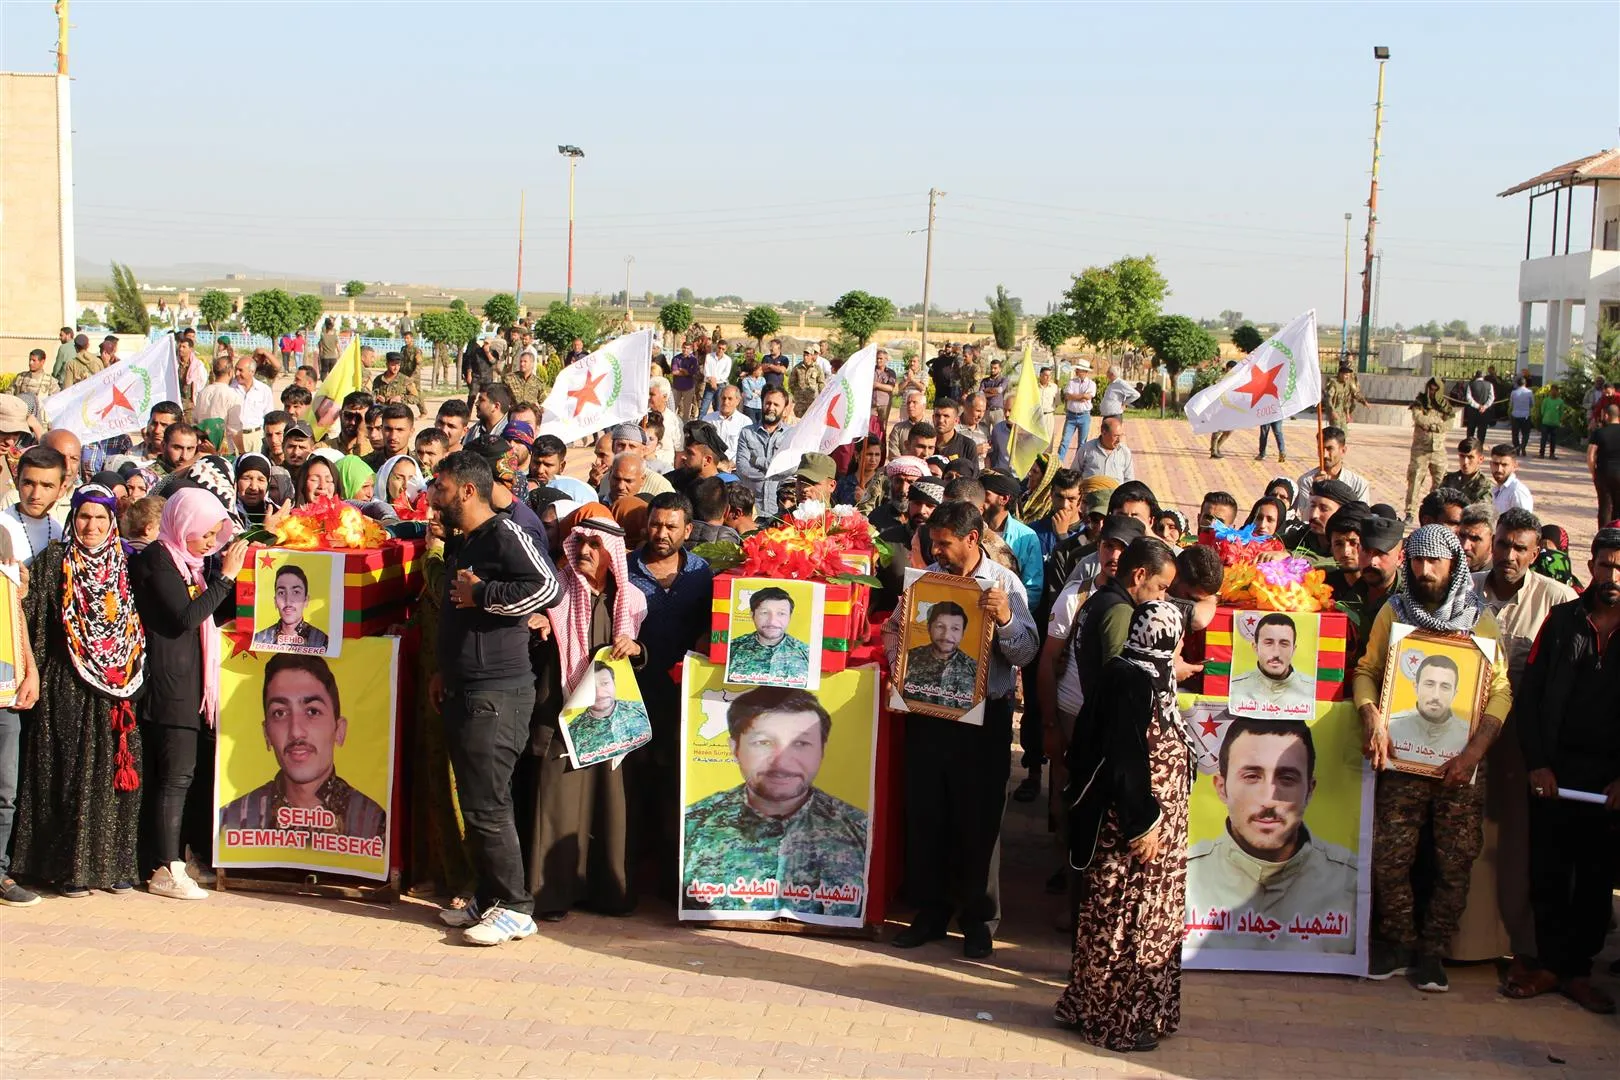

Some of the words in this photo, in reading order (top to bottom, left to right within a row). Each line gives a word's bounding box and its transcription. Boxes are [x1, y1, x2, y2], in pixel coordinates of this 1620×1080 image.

[0, 678, 17, 691] EKÊ
[1261, 702, 1281, 715] جهاد
[1283, 702, 1312, 716] الشهيد
[1393, 739, 1415, 754] الشبل
[1415, 744, 1436, 759] جهاد
[278, 806, 335, 828] ŞEHÎD
[226, 830, 308, 848] DEMHAT
[313, 833, 383, 858] HESEKÊ
[686, 878, 726, 904] مجيد
[728, 876, 779, 904] اللطيف
[782, 881, 811, 904] عبد
[813, 883, 861, 907] الشهيد
[1237, 910, 1282, 940] جهاد
[1288, 911, 1349, 941] الشهيد
